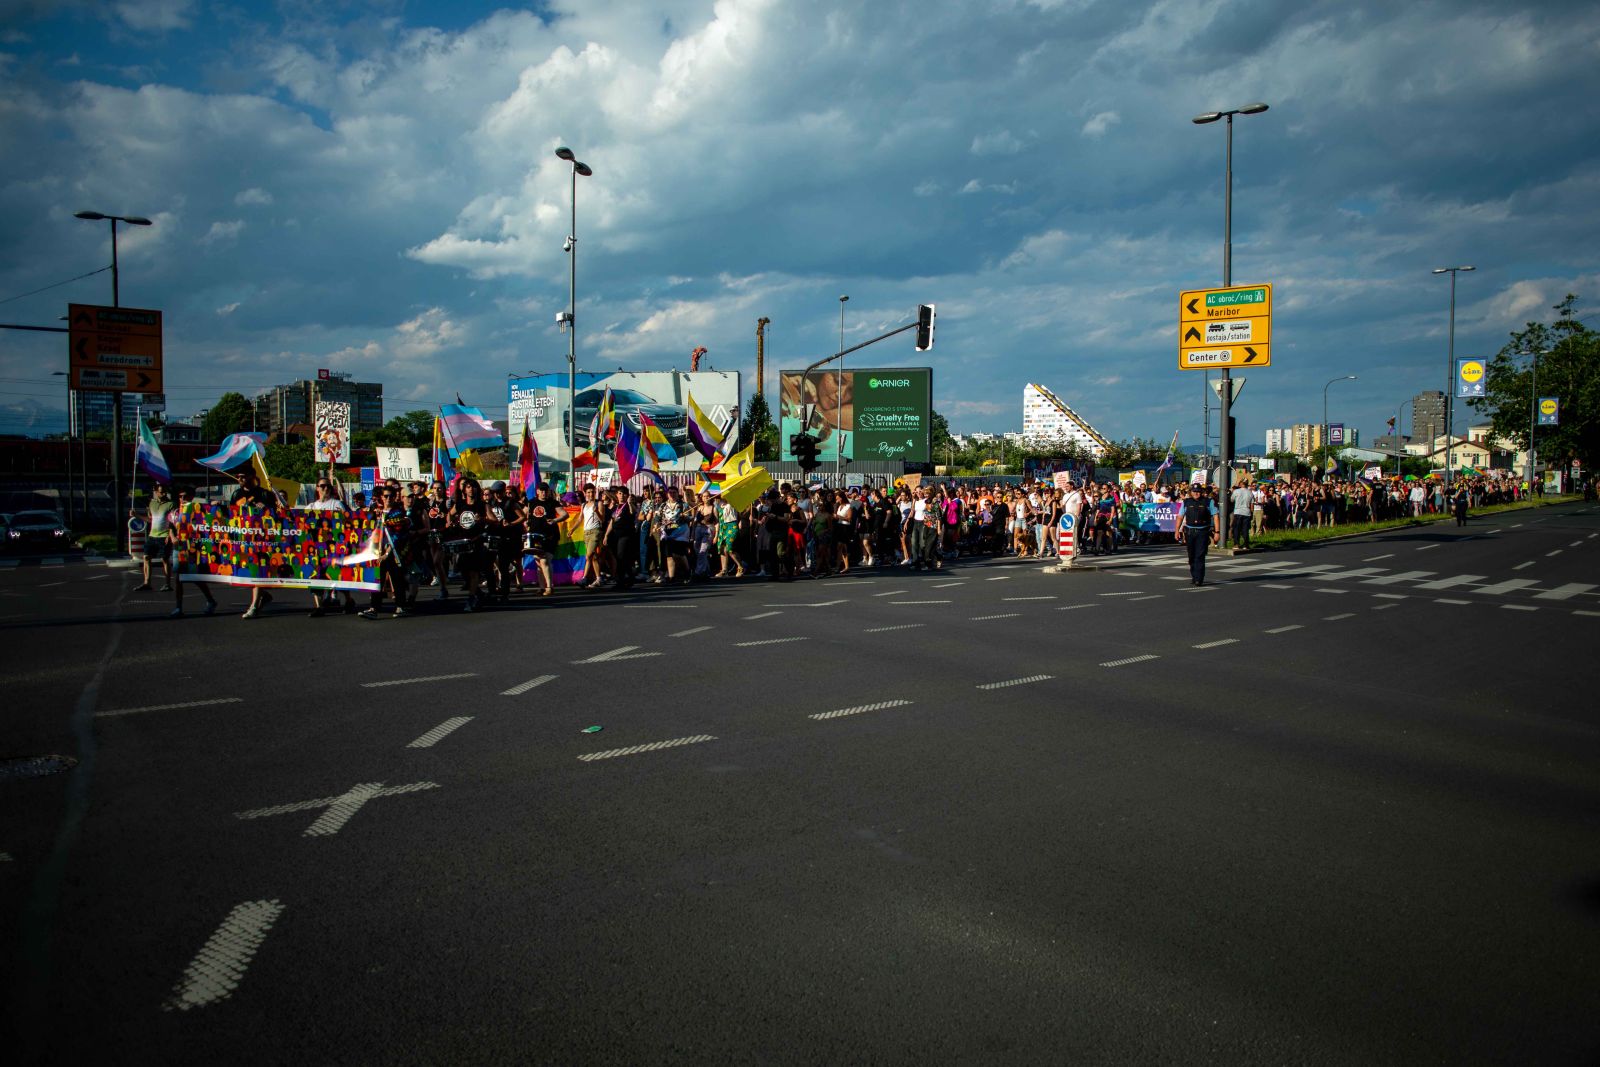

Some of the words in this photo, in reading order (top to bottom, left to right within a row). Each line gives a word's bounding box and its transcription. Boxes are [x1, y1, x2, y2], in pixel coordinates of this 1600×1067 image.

[1207, 295, 1216, 304] AC
[1207, 308, 1240, 317] Maribor
[1206, 332, 1250, 342] postaja/station
[100, 356, 140, 364] Aerodrom
[1190, 354, 1218, 362] Center
[869, 378, 910, 388] GARNIER
[512, 389, 534, 399] RENAULT
[512, 399, 535, 409] AUSTRAL
[536, 397, 554, 407] E-TECH
[512, 409, 524, 418] FULL
[876, 414, 902, 422] Cruelty
[192, 523, 210, 532] VEČ
